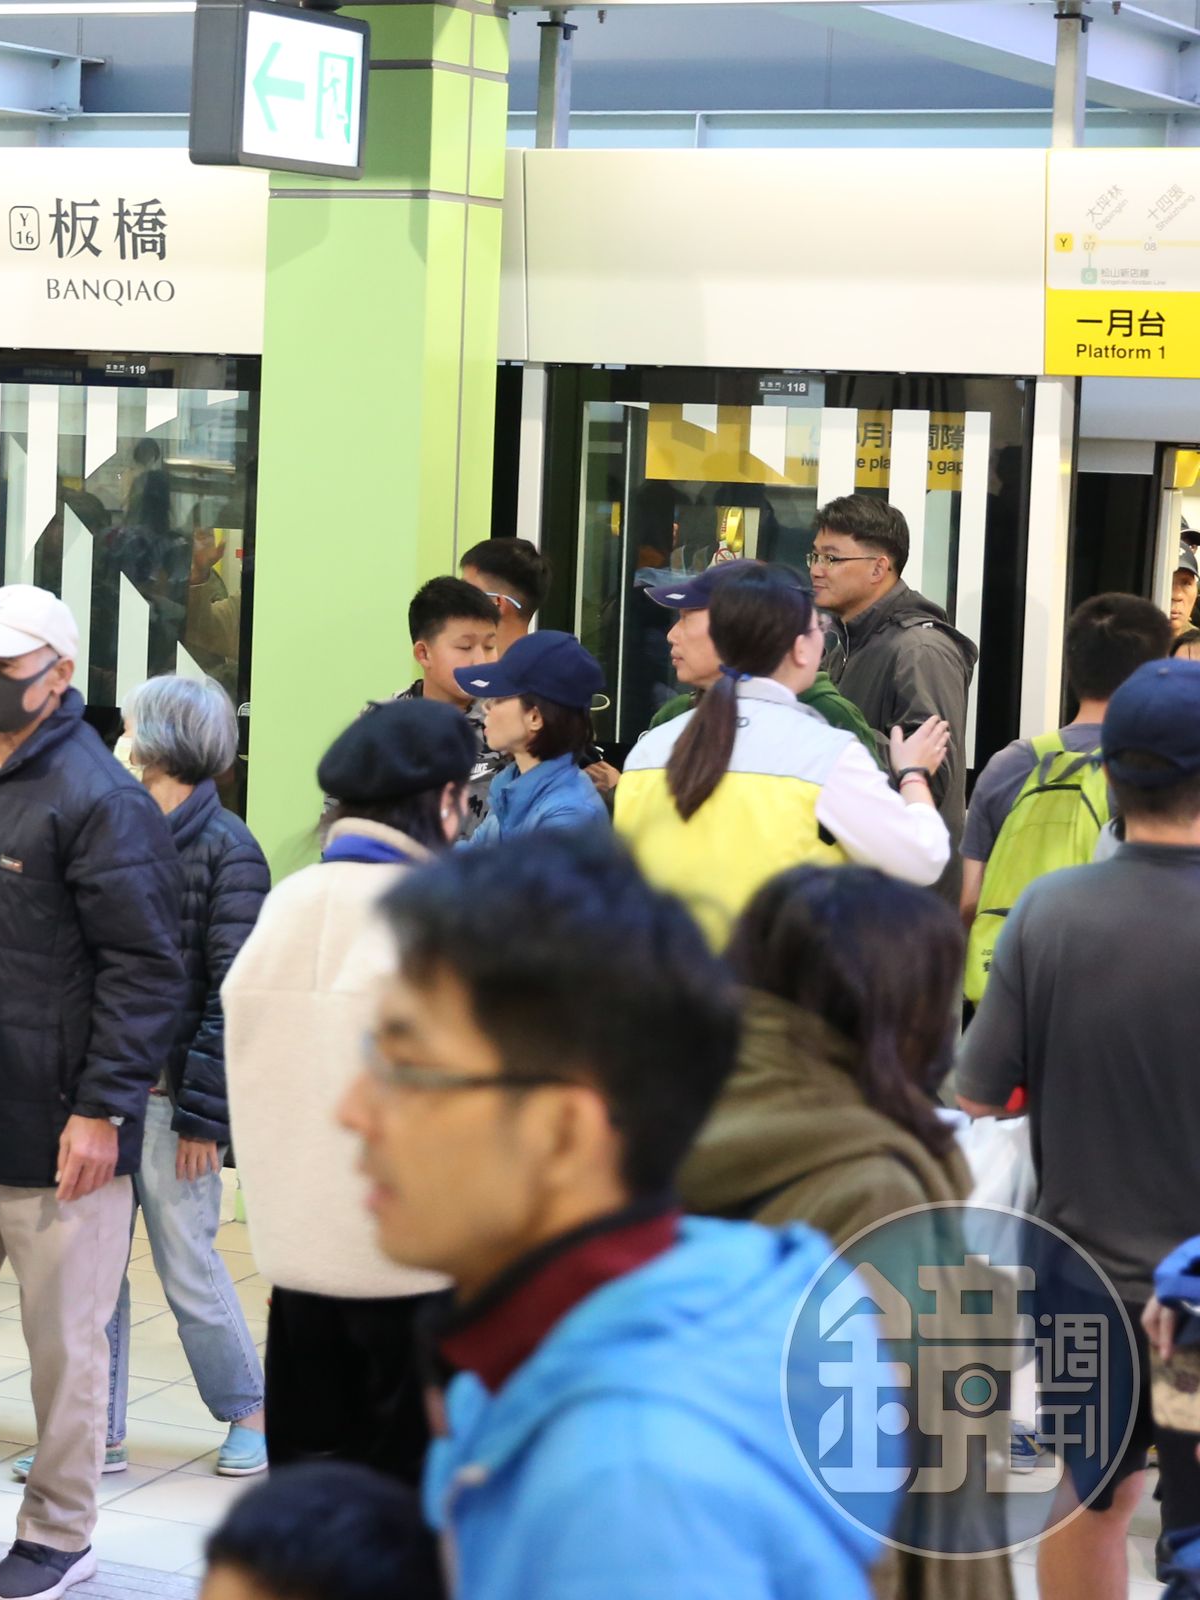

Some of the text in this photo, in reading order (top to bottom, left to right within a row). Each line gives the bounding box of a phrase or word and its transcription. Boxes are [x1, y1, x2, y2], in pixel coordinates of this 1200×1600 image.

[20, 213, 29, 227] Y
[48, 197, 168, 261] 板橋
[16, 231, 34, 245] 16
[1060, 238, 1067, 247] Y
[1144, 242, 1157, 252] 08
[46, 279, 175, 306] BANQIAO
[1076, 310, 1165, 337] 一月台
[1076, 344, 1166, 359] Platform 1
[130, 365, 146, 374] 119
[787, 382, 806, 392] 118
